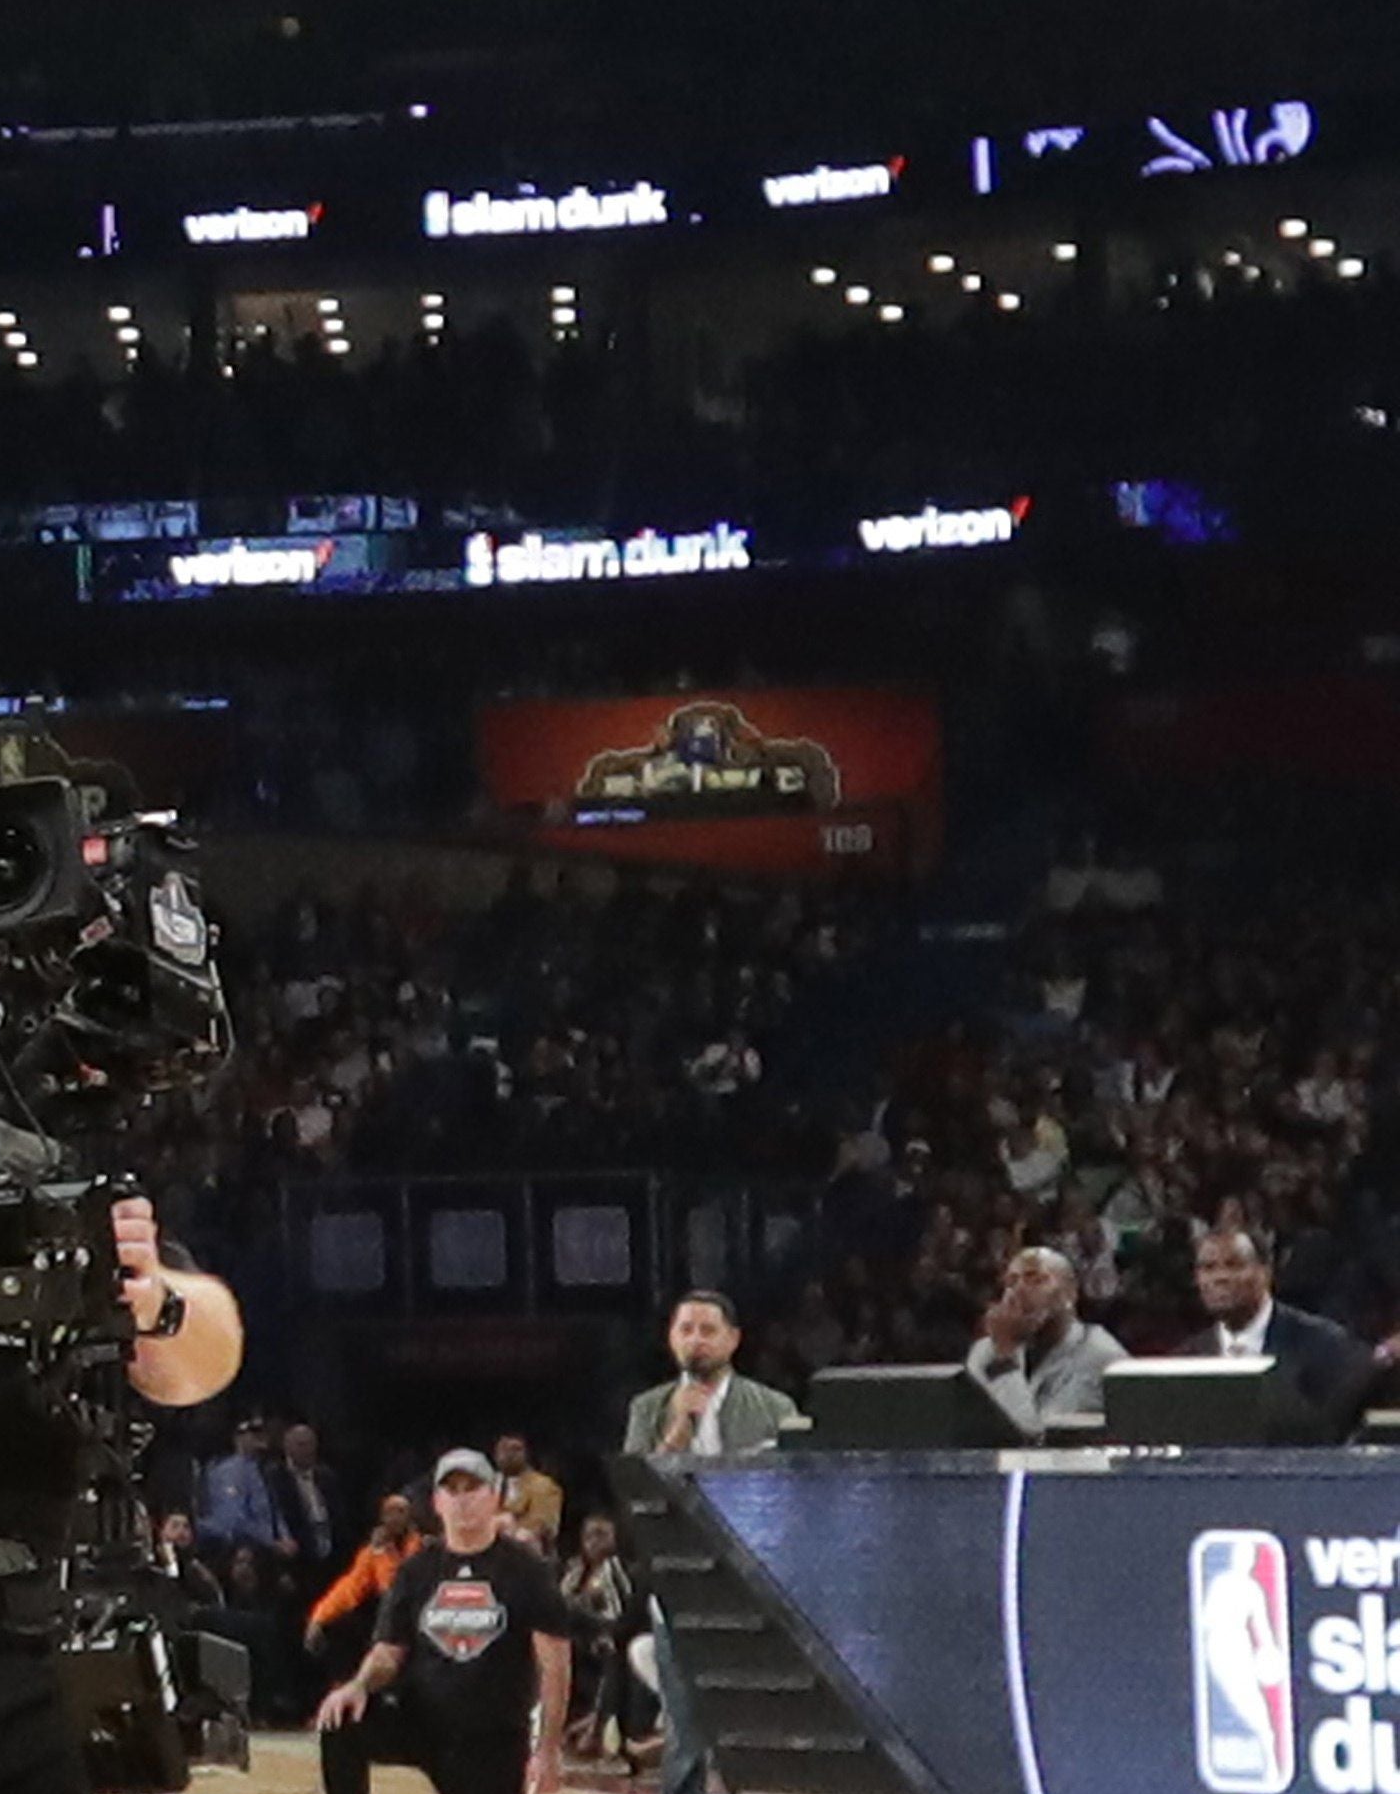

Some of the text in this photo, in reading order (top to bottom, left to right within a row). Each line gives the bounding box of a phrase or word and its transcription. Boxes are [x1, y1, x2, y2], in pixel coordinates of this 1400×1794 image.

[451, 181, 668, 236] slam dunk
[763, 164, 890, 206] verizon
[185, 207, 308, 243] verizon
[496, 523, 750, 583] slam dunk
[857, 504, 1012, 553] verizon
[170, 539, 316, 586] verizon
[1304, 1536, 1400, 1589] ver
[1309, 1591, 1400, 1696] sl
